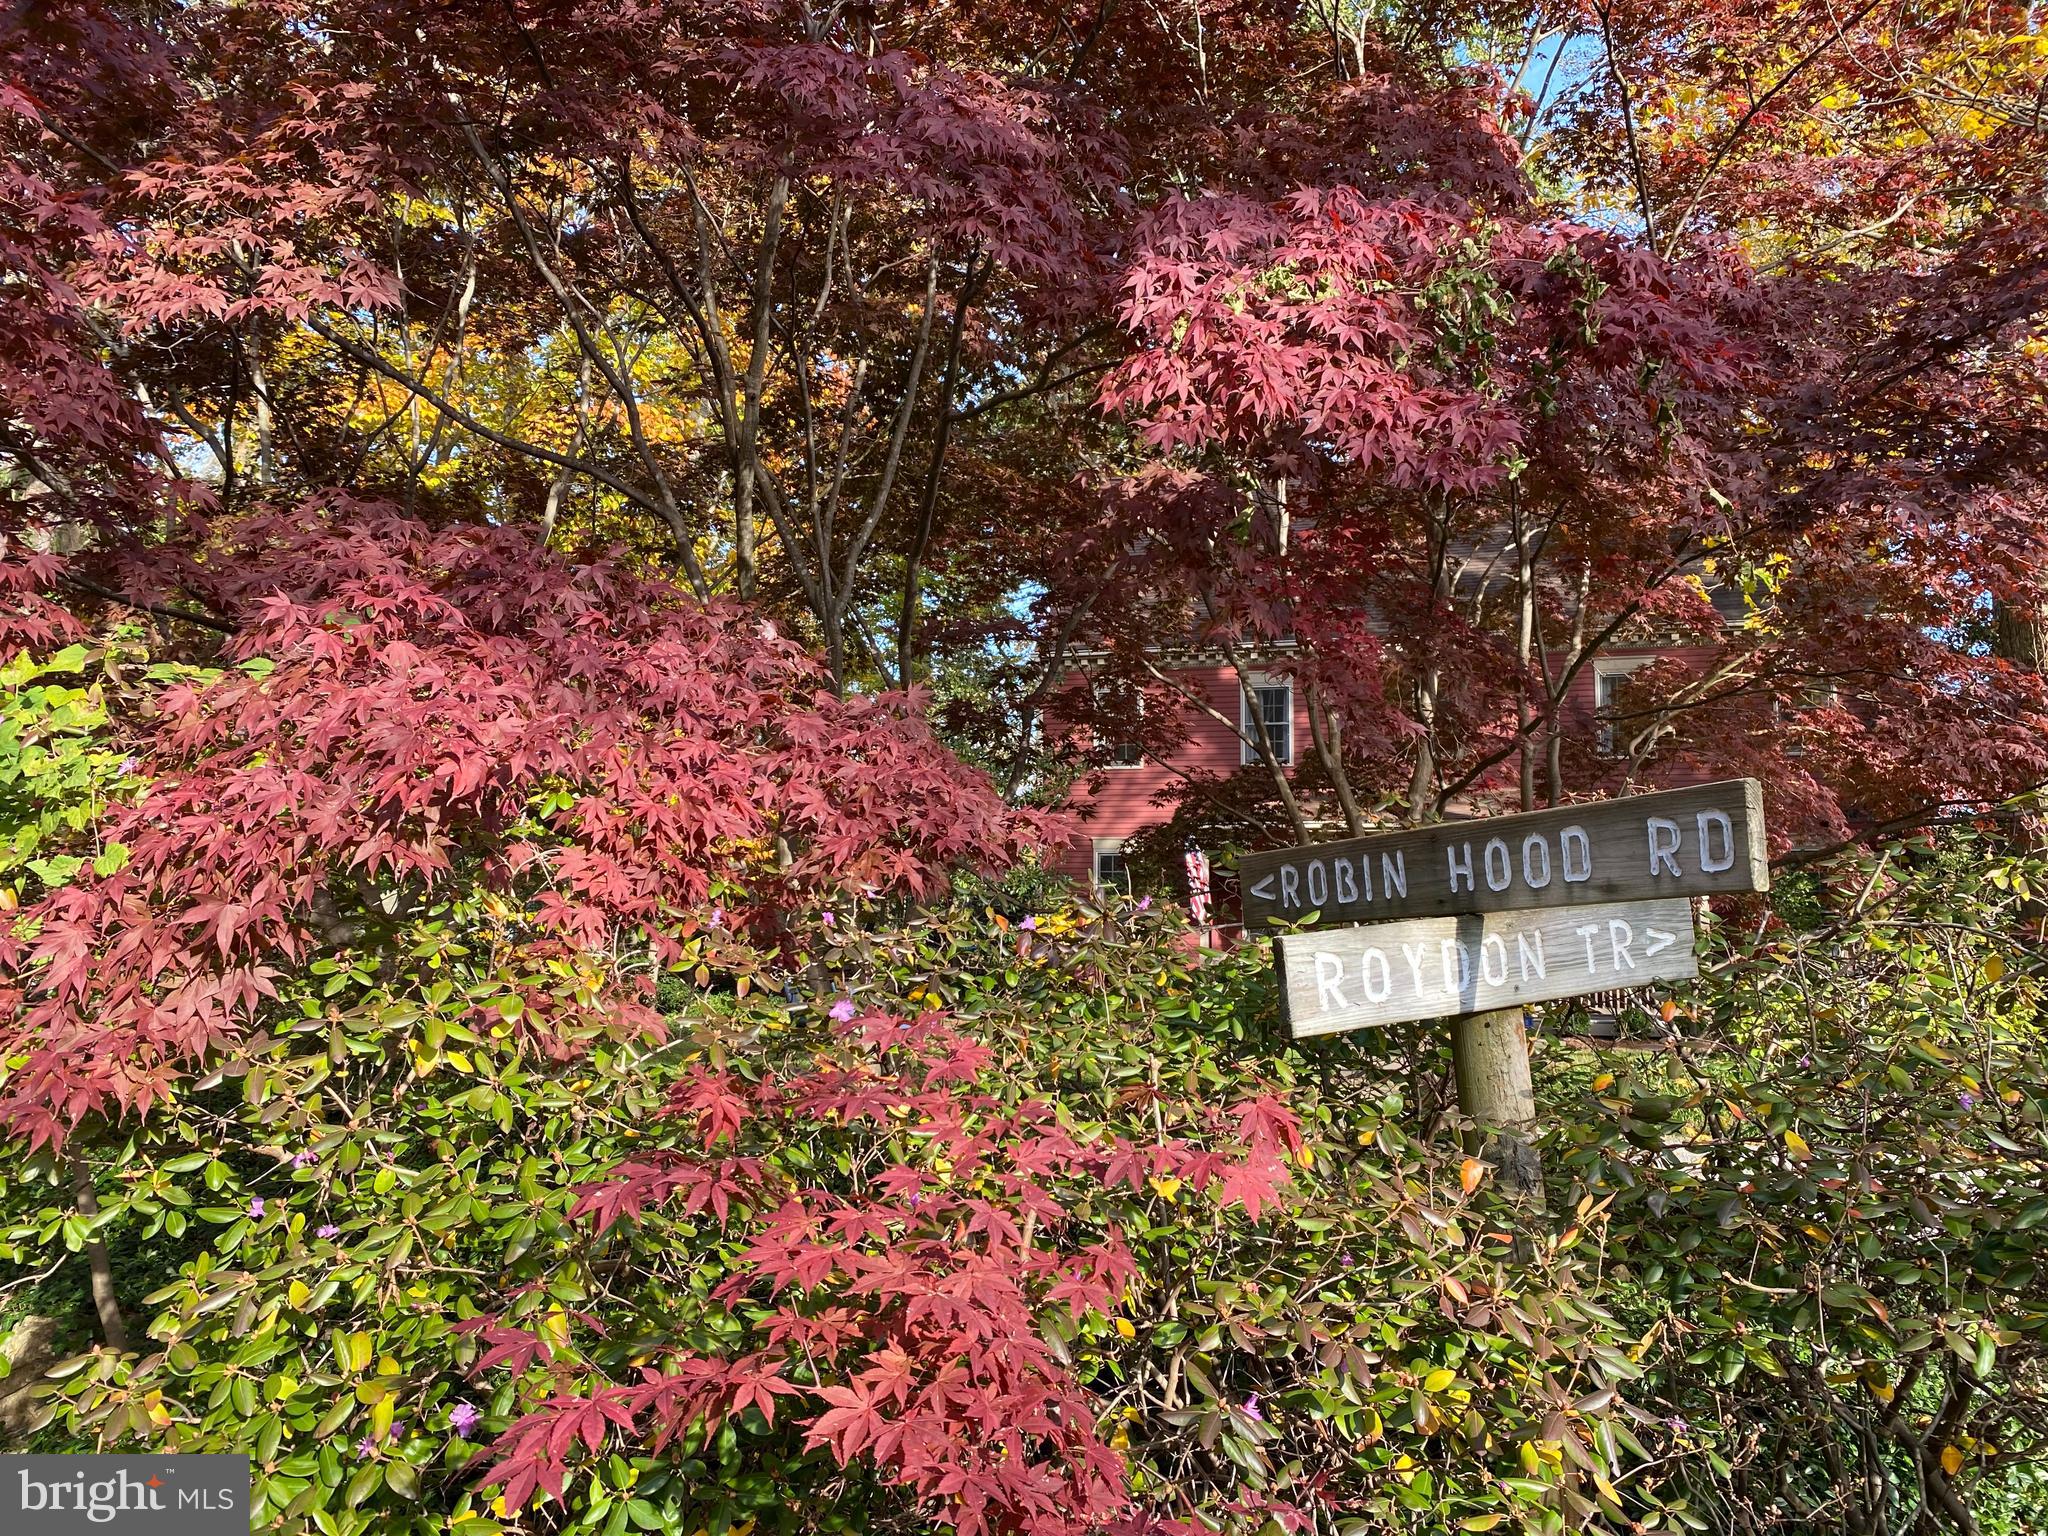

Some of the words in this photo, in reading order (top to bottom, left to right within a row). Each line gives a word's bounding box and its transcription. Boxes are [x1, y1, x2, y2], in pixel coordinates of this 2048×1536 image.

[1280, 850, 1407, 909] ROBIN
[1447, 825, 1592, 893] HOOD
[1646, 808, 1735, 878] RD
[1312, 928, 1546, 1012] ROYDON
[1576, 918, 1637, 974] TR
